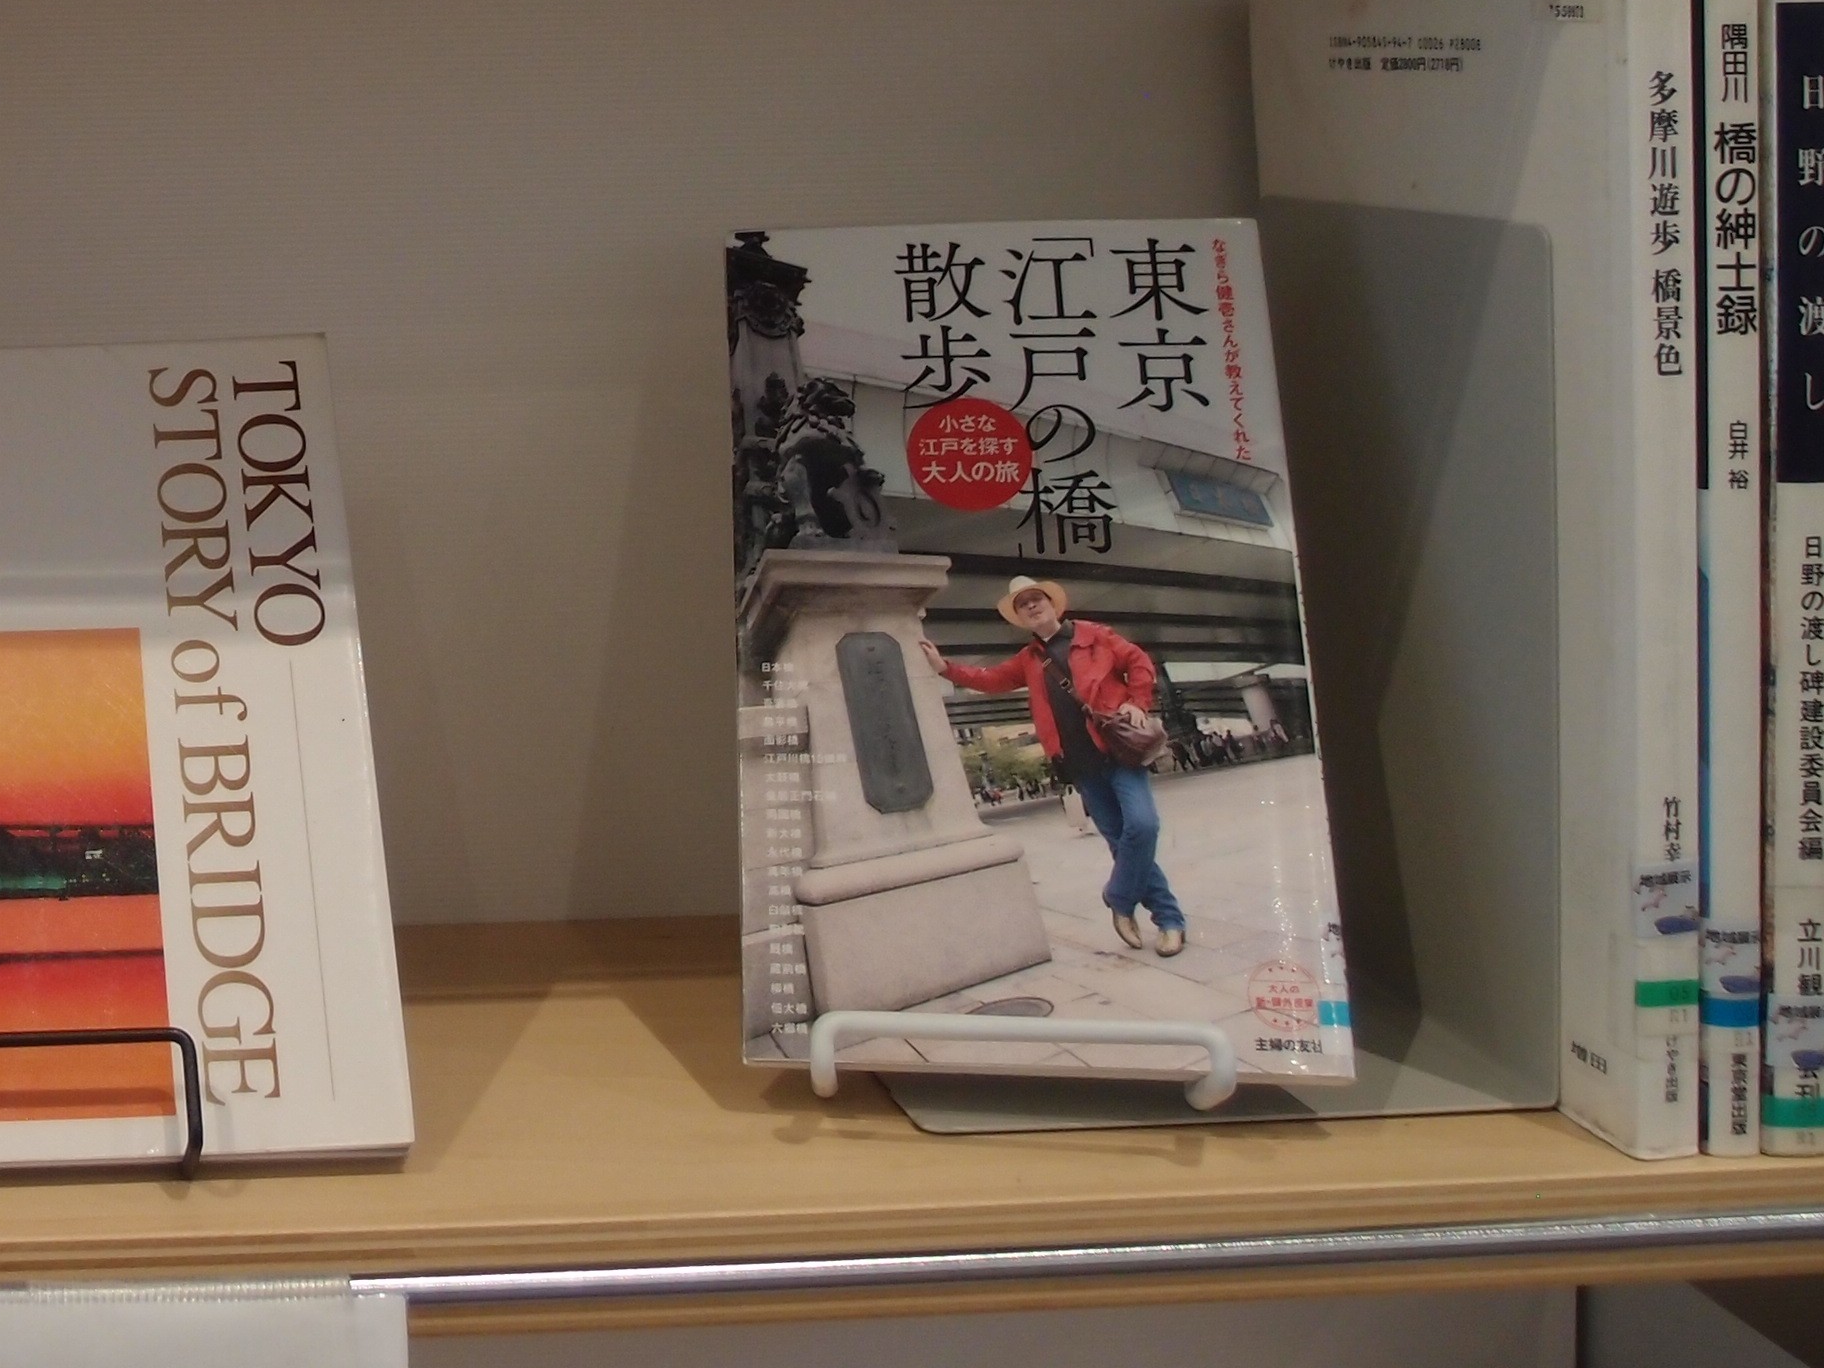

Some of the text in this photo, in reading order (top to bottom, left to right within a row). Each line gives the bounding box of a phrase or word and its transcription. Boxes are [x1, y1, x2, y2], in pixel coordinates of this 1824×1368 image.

[1647, 70, 1683, 377] 多摩川遊歩 橋景色
[1714, 23, 1757, 336] 隅田川 橋の紳士録
[894, 241, 992, 410] 散歩
[939, 413, 998, 433] 小さな
[999, 237, 1117, 559] 「江戸の橋」
[1110, 238, 1211, 412] 東京
[231, 360, 327, 648] TOKYO
[919, 435, 1018, 458] 江戸を探す
[921, 461, 1021, 486] 大人の旅
[146, 367, 281, 1109] STORY of BRIDGE
[1798, 535, 1824, 861] 日野の渡し碑建設委員会編
[1255, 1037, 1324, 1054] 主婦の友社
